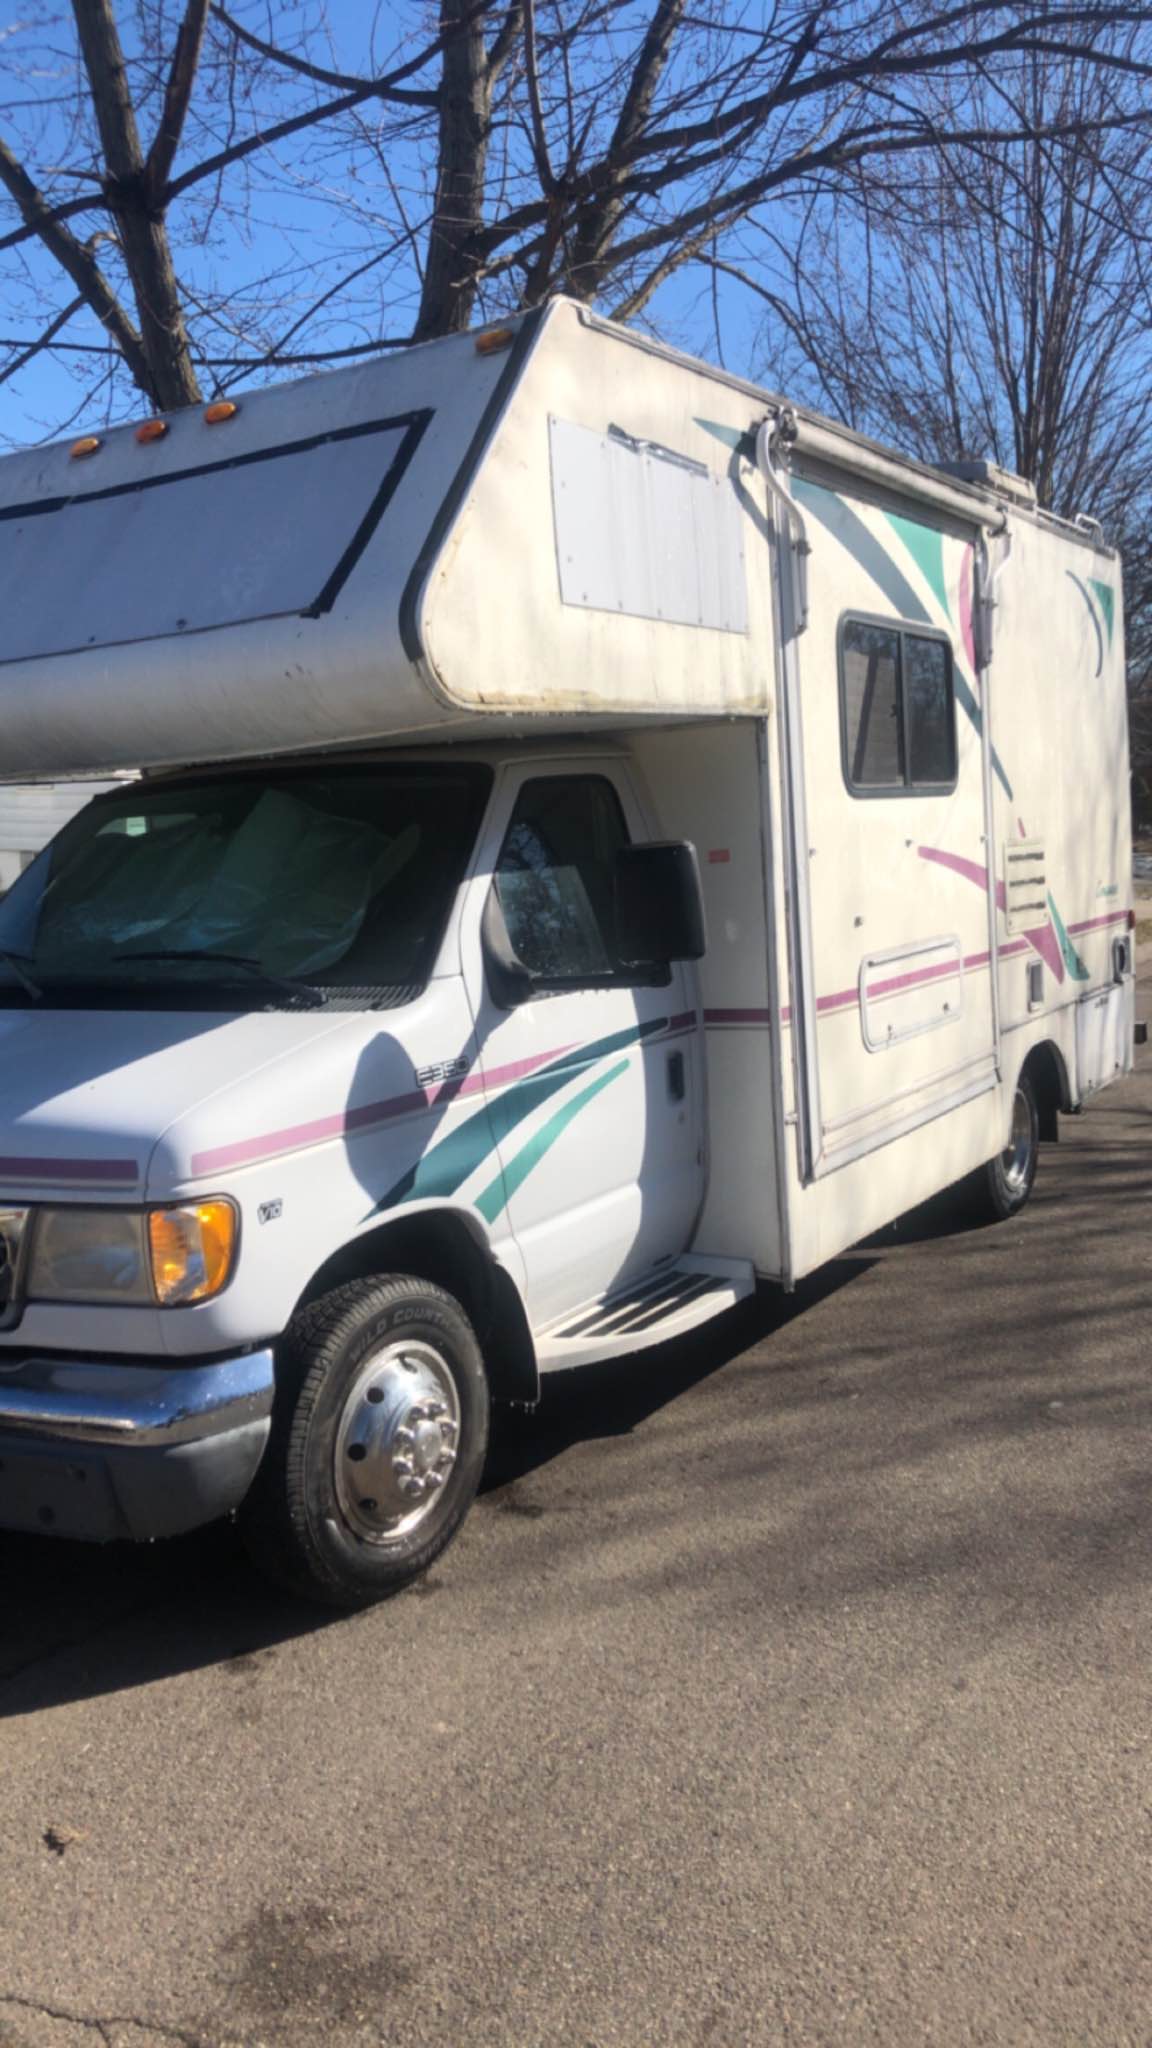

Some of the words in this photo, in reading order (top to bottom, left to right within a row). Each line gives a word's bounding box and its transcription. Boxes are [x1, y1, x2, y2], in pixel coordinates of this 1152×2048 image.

[415, 1056, 469, 1088] E350
[257, 1202, 282, 1225] V10
[349, 1318, 388, 1361] WILD
